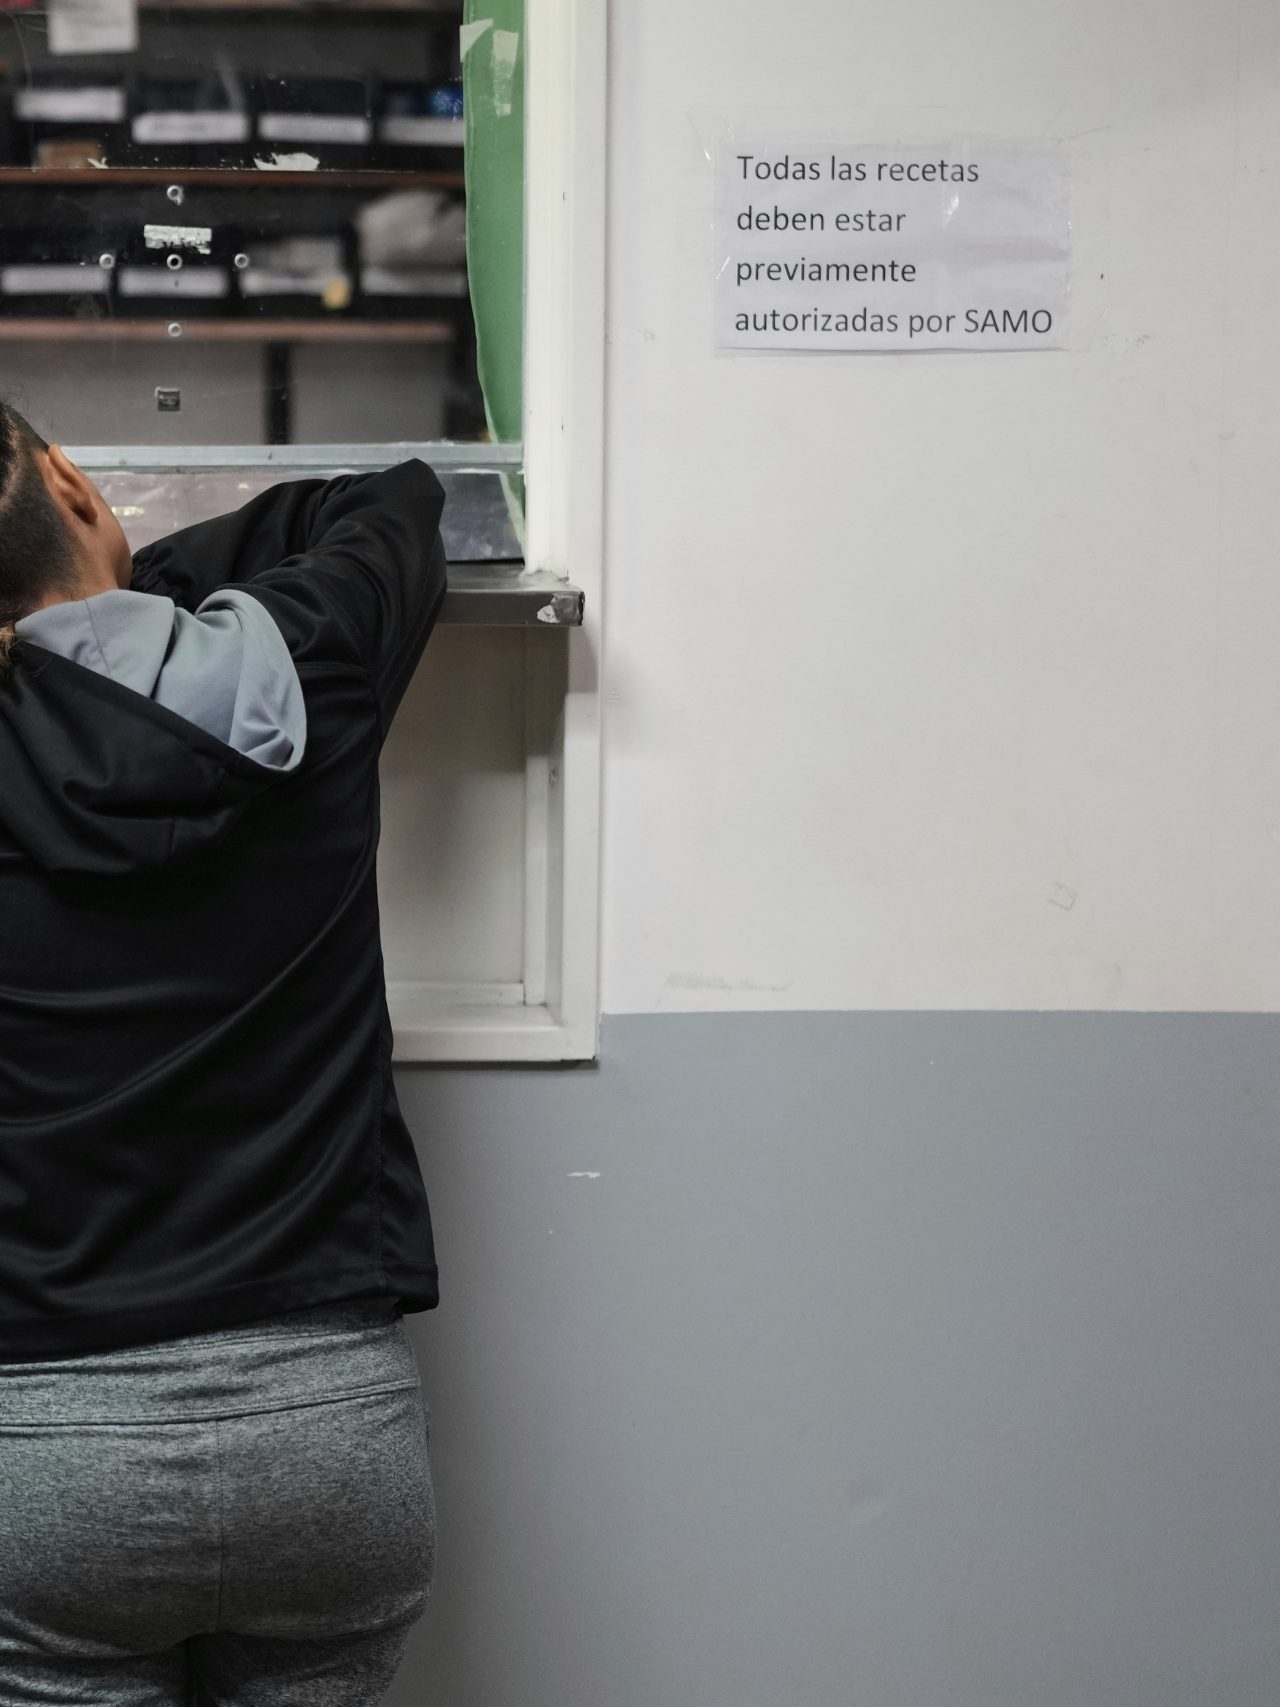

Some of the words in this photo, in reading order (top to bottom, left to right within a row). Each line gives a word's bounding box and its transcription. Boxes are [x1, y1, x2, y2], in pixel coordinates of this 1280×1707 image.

[737, 155, 821, 181] Todas
[831, 155, 867, 181] las
[877, 158, 979, 182] recetas
[736, 205, 824, 232] deben
[834, 209, 907, 232] estar
[736, 257, 916, 286] previamente
[735, 307, 898, 333] autorizadas
[909, 311, 956, 338] por
[964, 308, 1053, 334] SAMO
